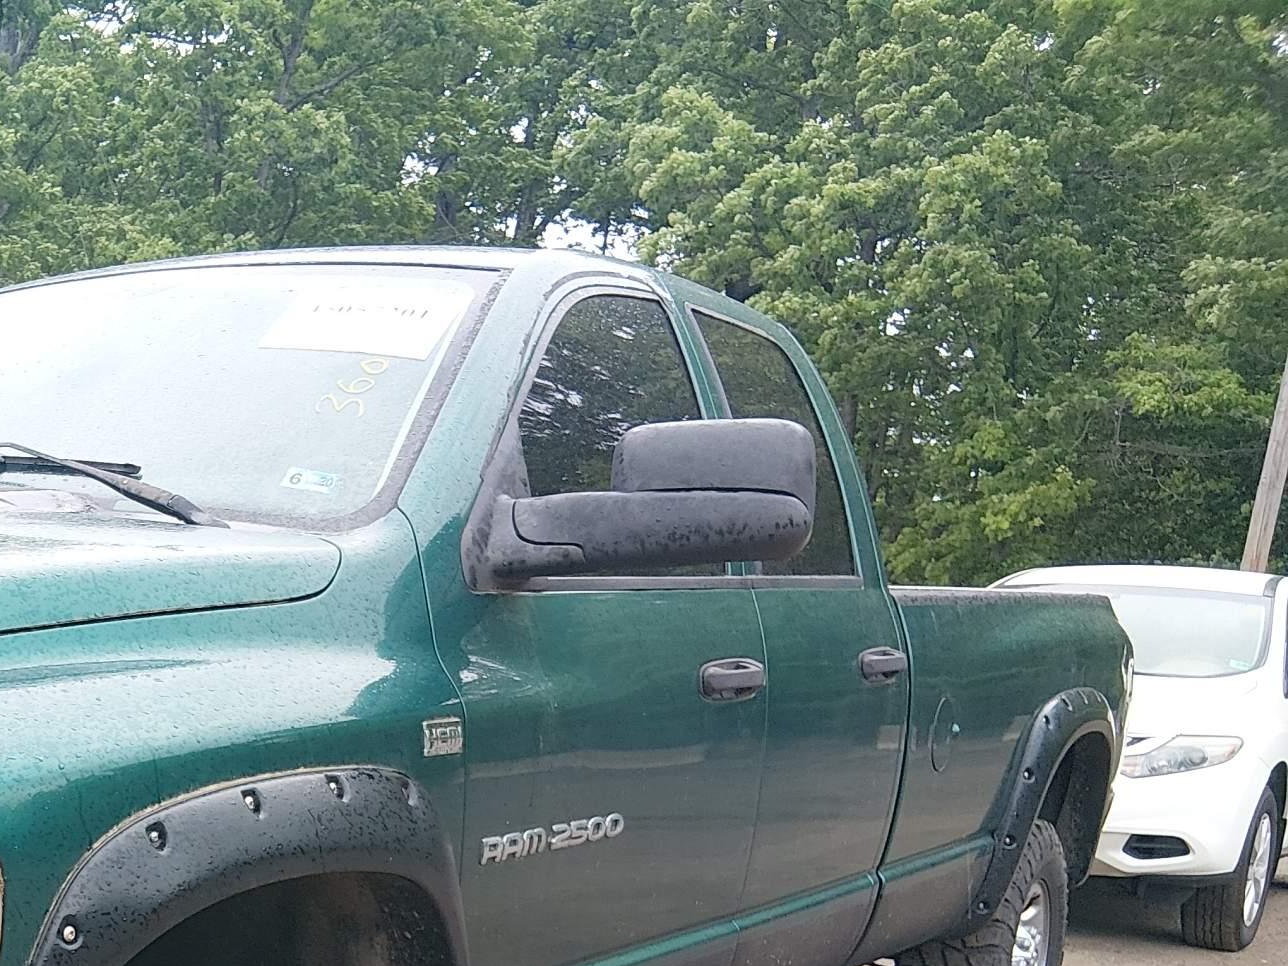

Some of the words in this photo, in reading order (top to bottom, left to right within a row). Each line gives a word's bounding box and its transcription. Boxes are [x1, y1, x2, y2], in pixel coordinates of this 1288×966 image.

[314, 358, 389, 417] 360
[288, 472, 304, 486] 6
[481, 827, 546, 865] RAM
[550, 812, 624, 850] 2500
